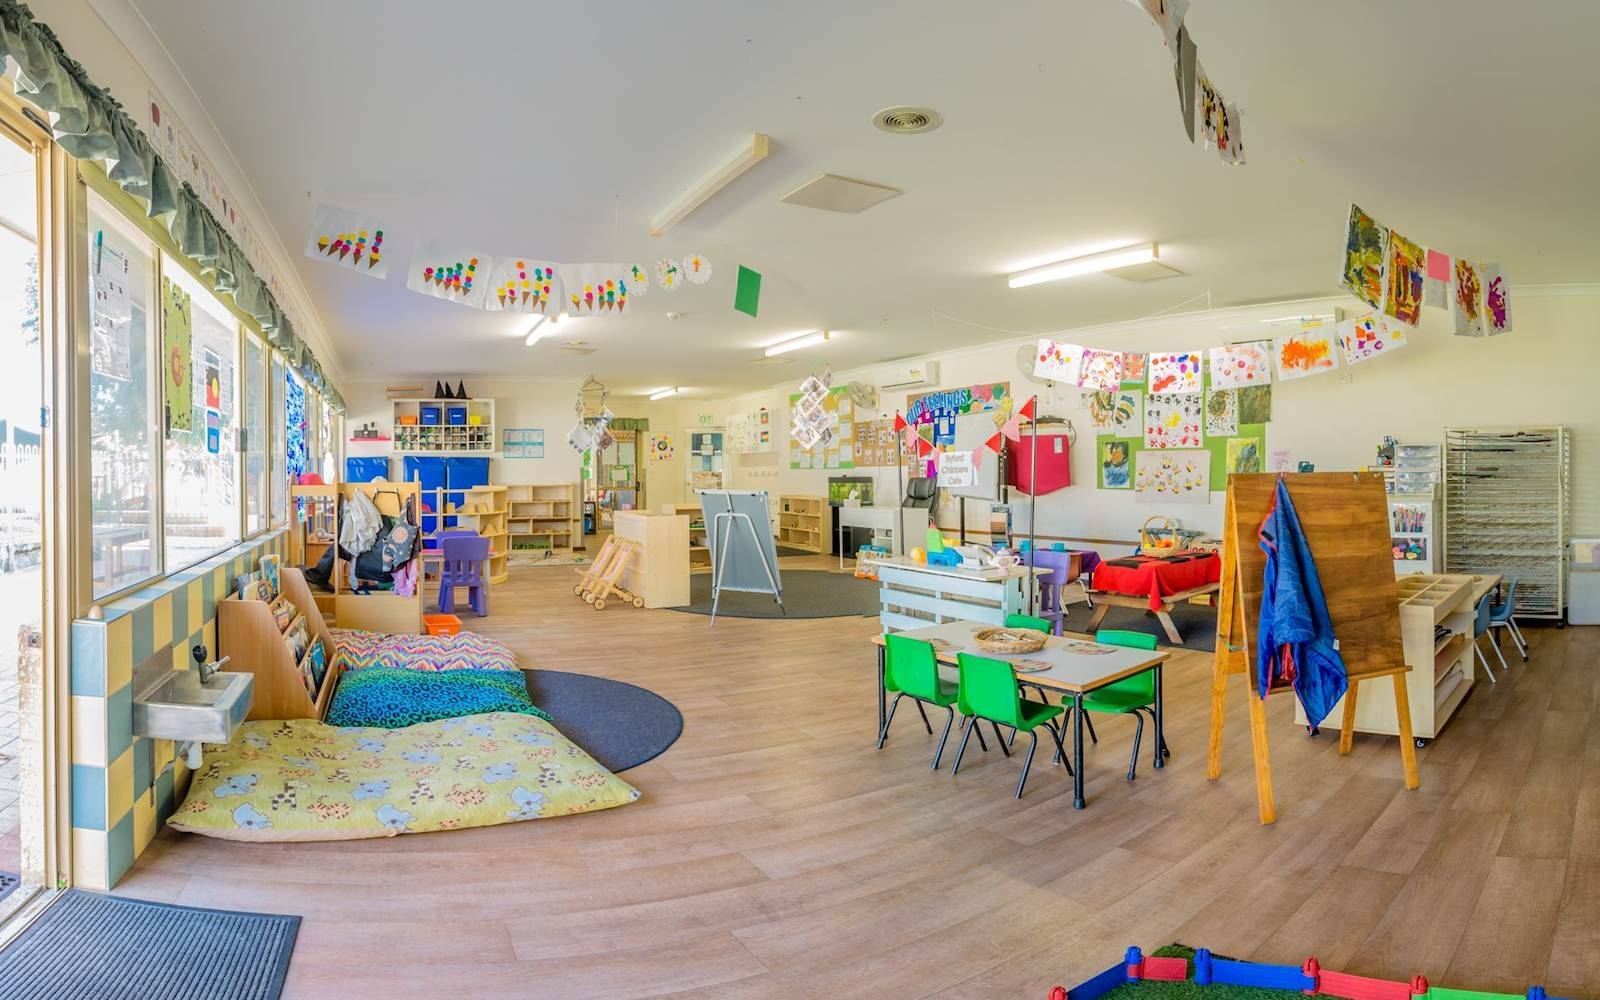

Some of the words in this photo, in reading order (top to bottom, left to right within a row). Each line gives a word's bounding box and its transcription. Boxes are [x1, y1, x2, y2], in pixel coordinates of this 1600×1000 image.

[907, 399, 922, 425] OUR
[922, 388, 967, 410] FEELINGS
[945, 454, 964, 464] Byford
[942, 466, 969, 474] Childcare
